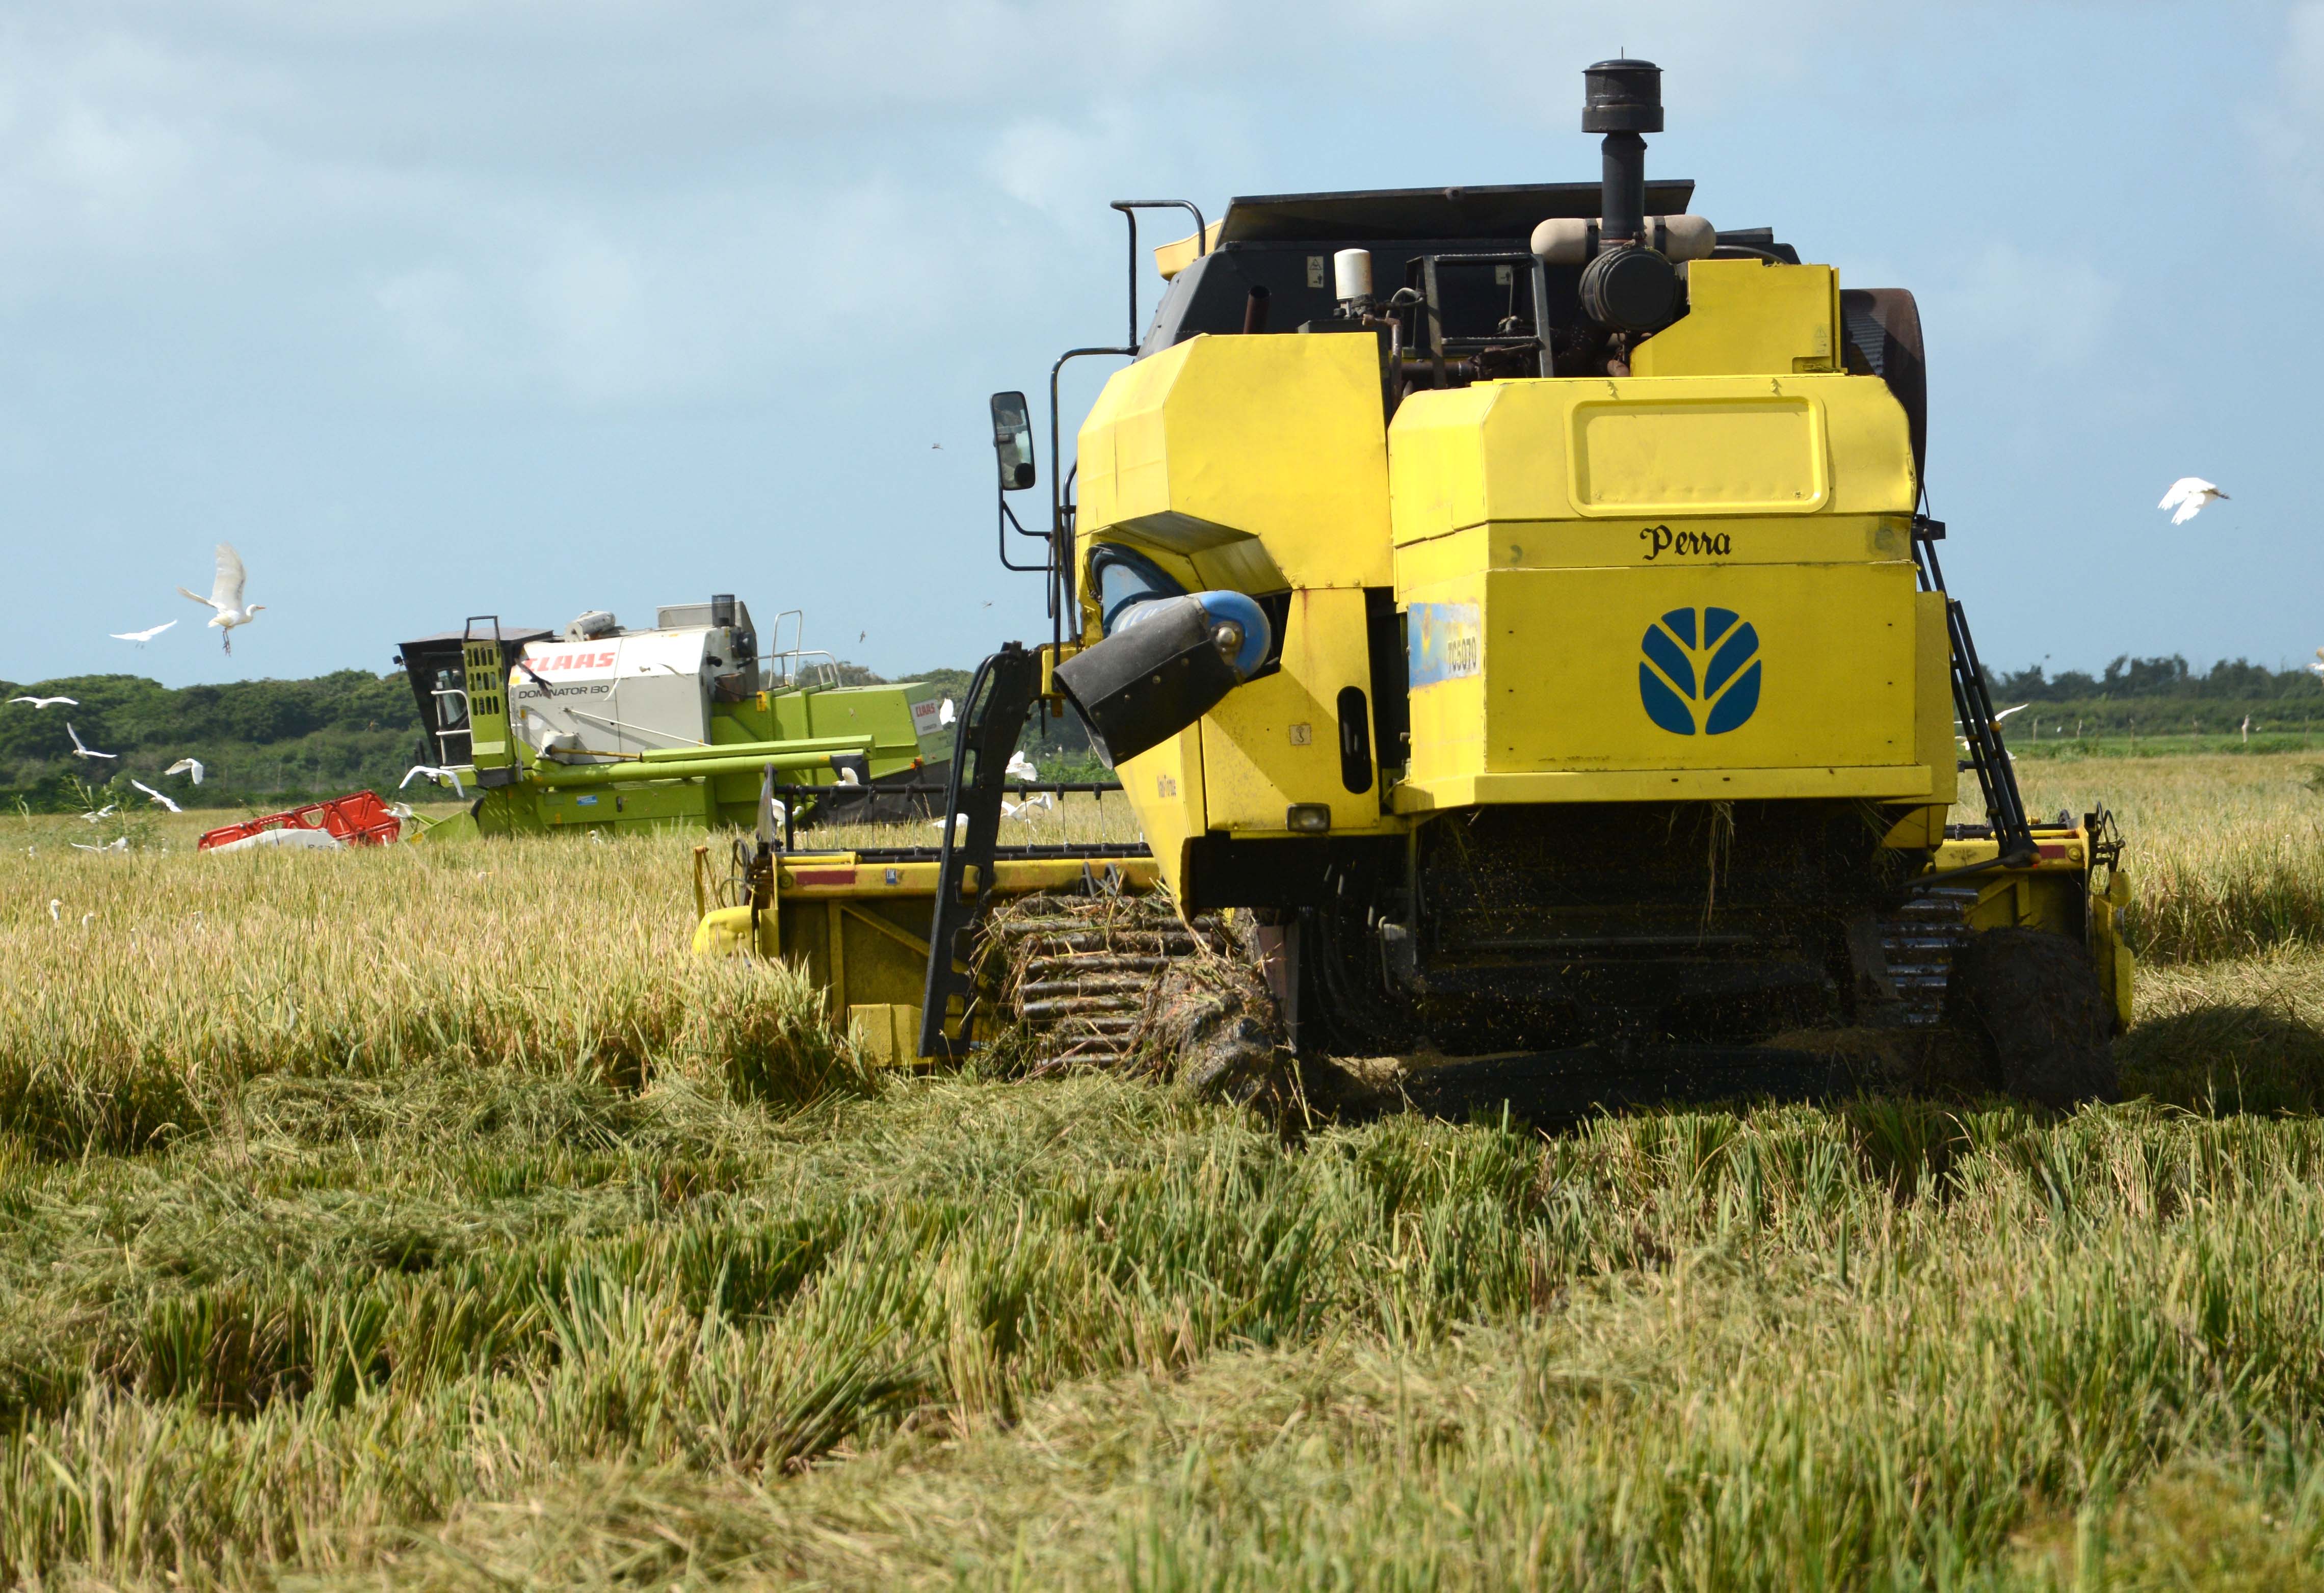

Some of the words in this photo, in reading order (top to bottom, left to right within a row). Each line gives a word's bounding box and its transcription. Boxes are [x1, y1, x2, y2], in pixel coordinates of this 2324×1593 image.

[1640, 524, 1732, 561] Perra
[521, 652, 616, 673] CLAAS
[1447, 636, 1476, 673] TC5070
[518, 686, 588, 699] DOMNATOR
[591, 685, 610, 694] 130
